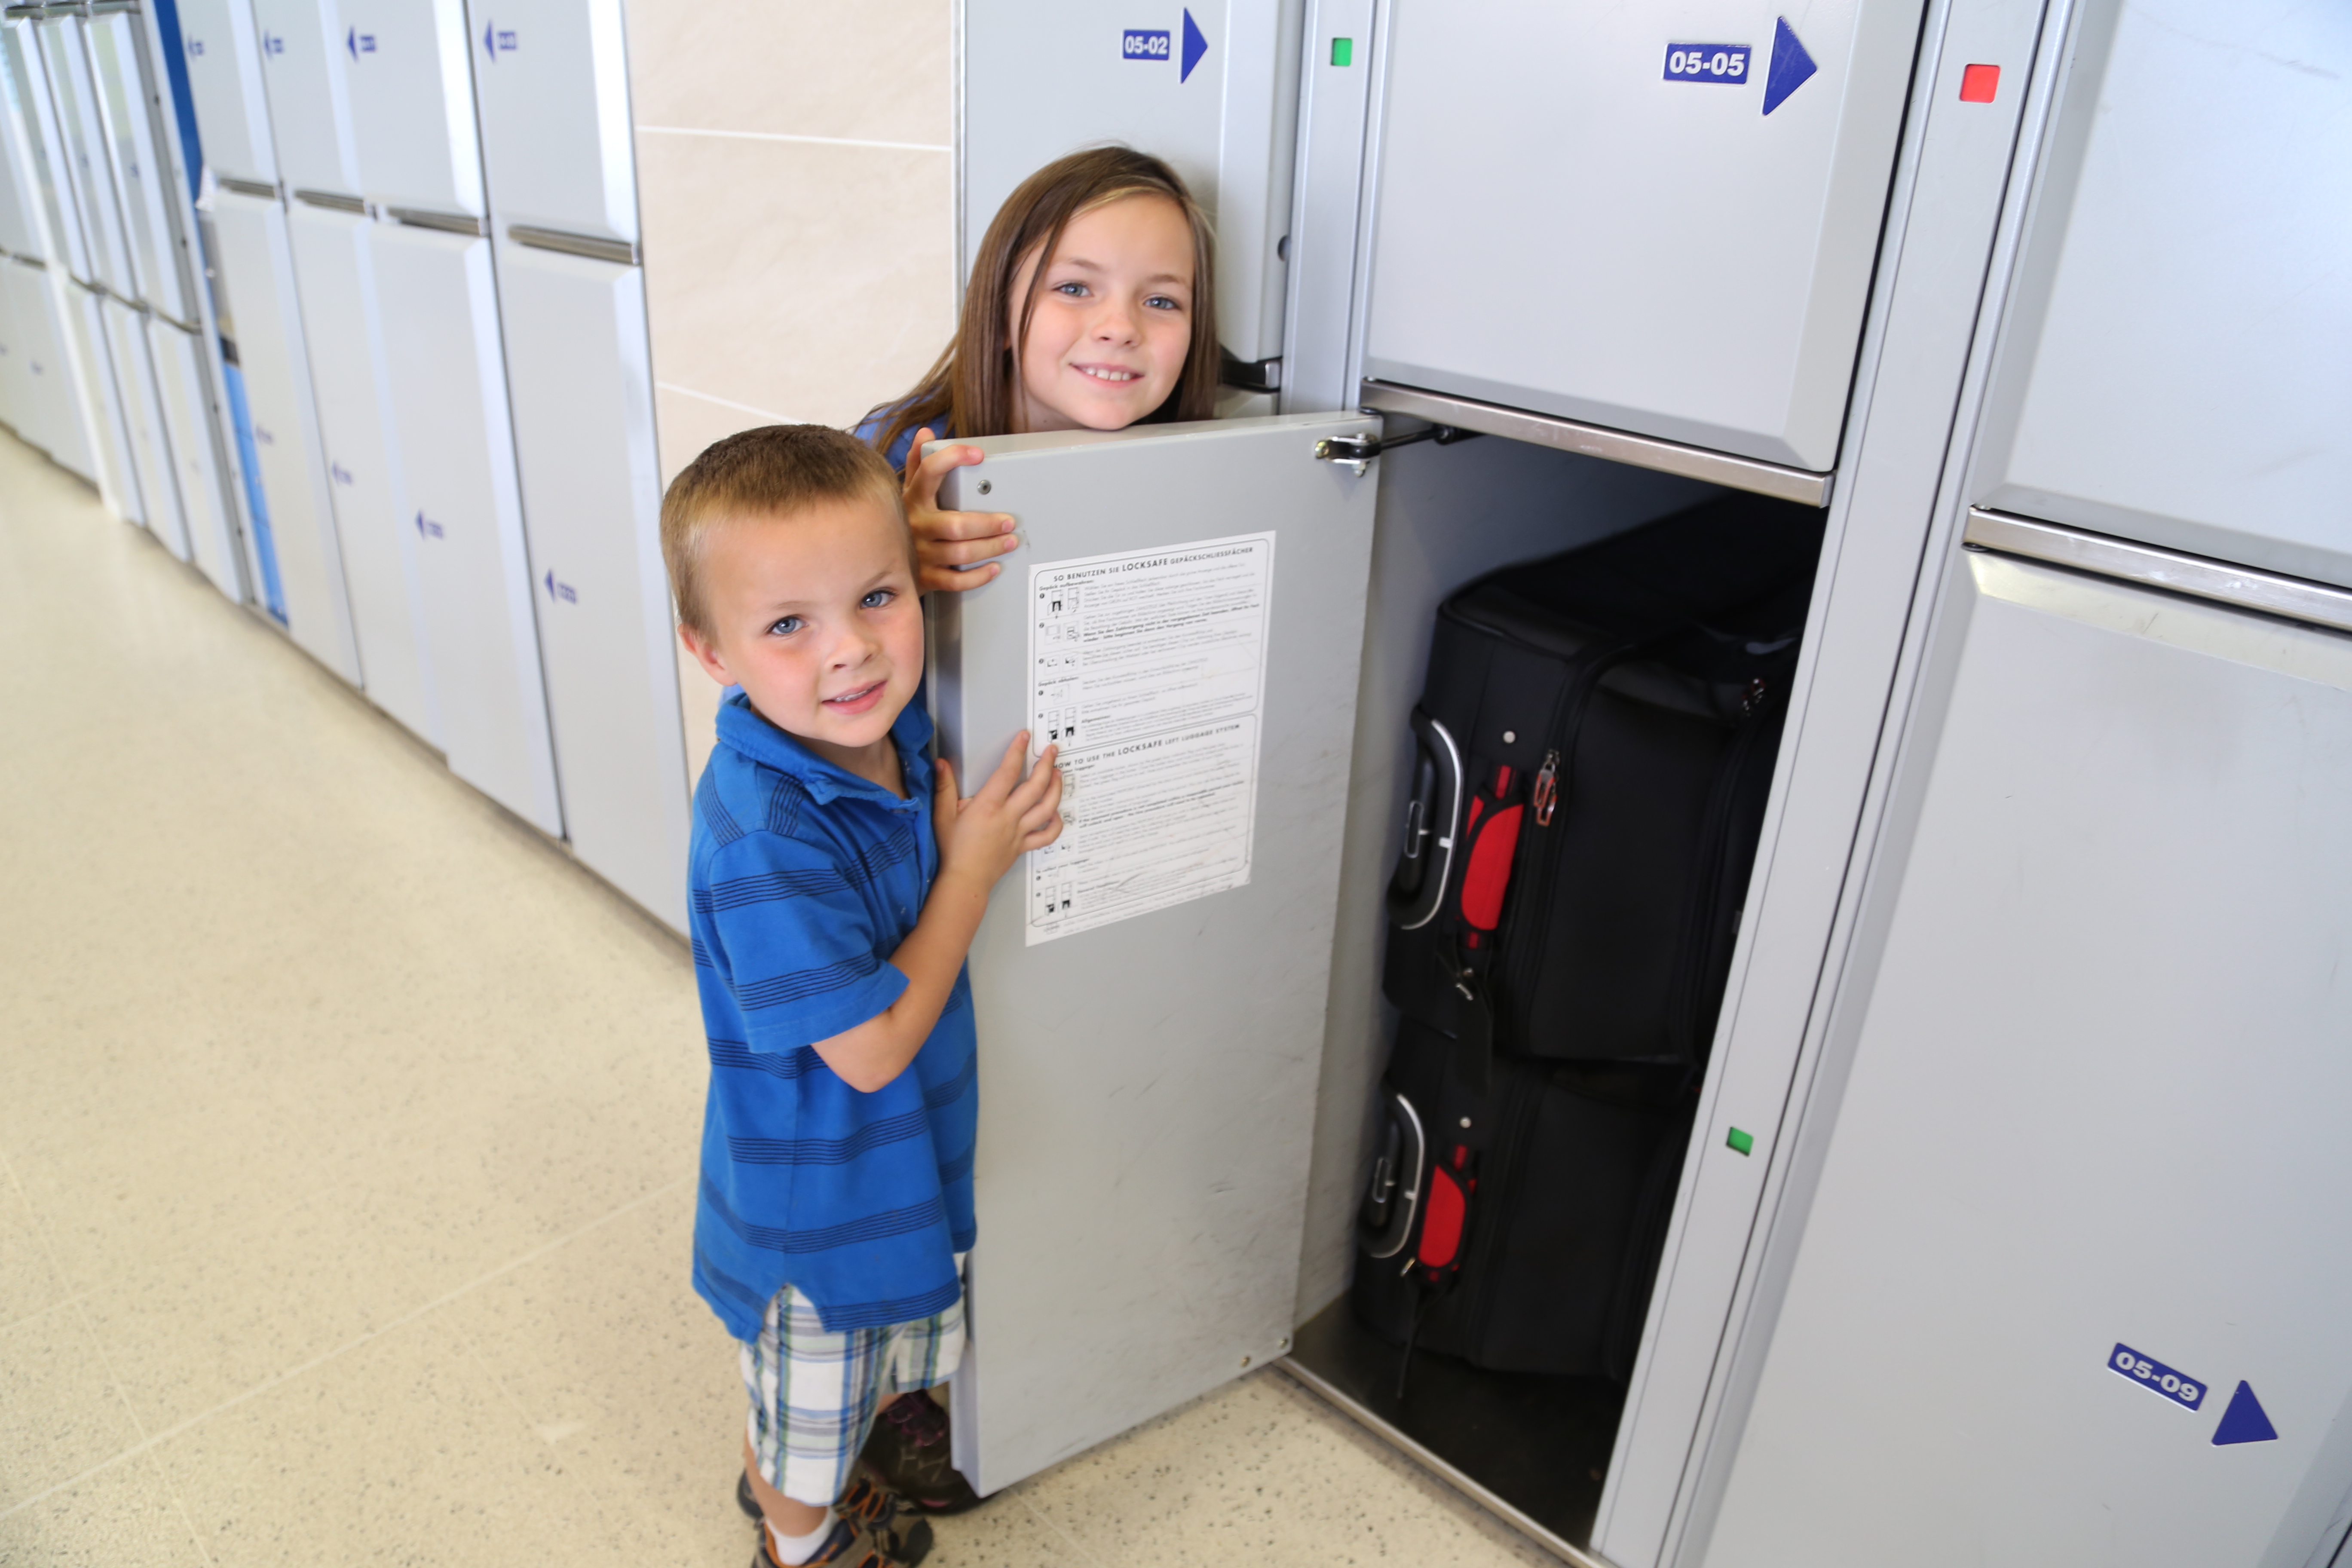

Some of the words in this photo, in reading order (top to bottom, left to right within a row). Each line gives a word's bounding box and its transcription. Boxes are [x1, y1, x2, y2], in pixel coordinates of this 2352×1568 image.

[1124, 35, 1168, 55] 05-02
[1669, 51, 1745, 76] 05-05
[1067, 567, 1106, 580] BENUTZEN
[1122, 558, 1167, 571] LOCKSAFE
[1118, 740, 1162, 755] LOCKSAFE
[1165, 737, 1179, 745] LEFT
[1182, 730, 1213, 741] LUGGAGE
[2116, 1352, 2199, 1402] 05-09
